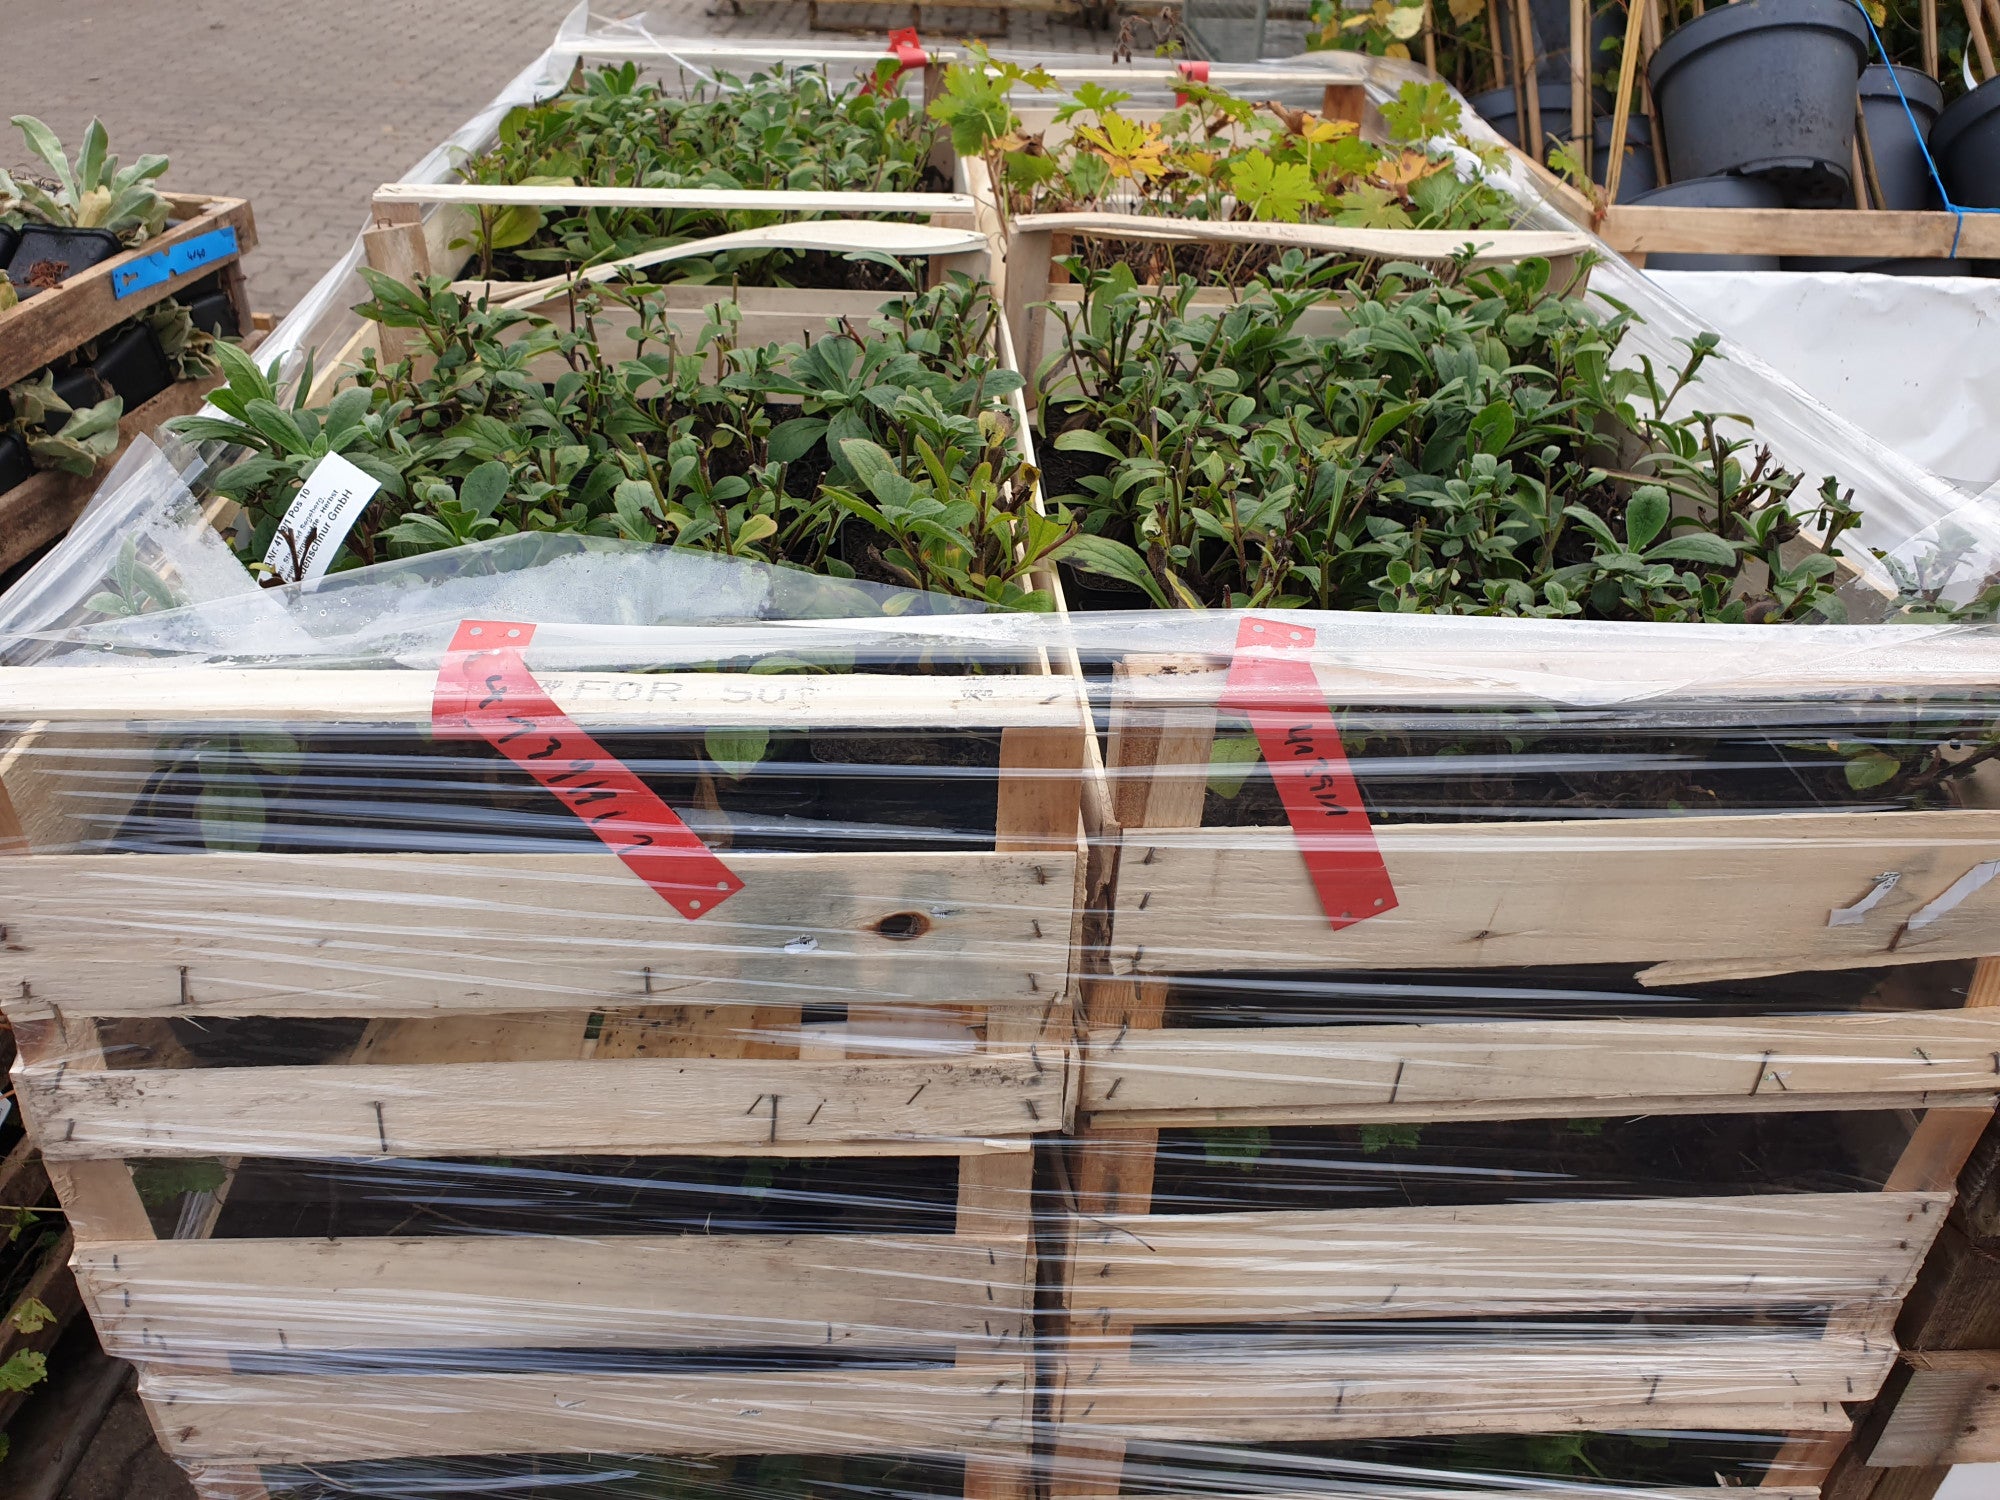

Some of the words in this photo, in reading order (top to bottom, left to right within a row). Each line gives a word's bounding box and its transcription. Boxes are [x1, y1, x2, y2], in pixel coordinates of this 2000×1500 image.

[275, 518, 292, 546] 419/1
[288, 502, 303, 519] Pos
[303, 487, 311, 500] 10
[321, 489, 339, 514] Herbst
[299, 522, 332, 580] edenschnur
[328, 488, 353, 521] GmbH
[571, 680, 683, 702] FOR
